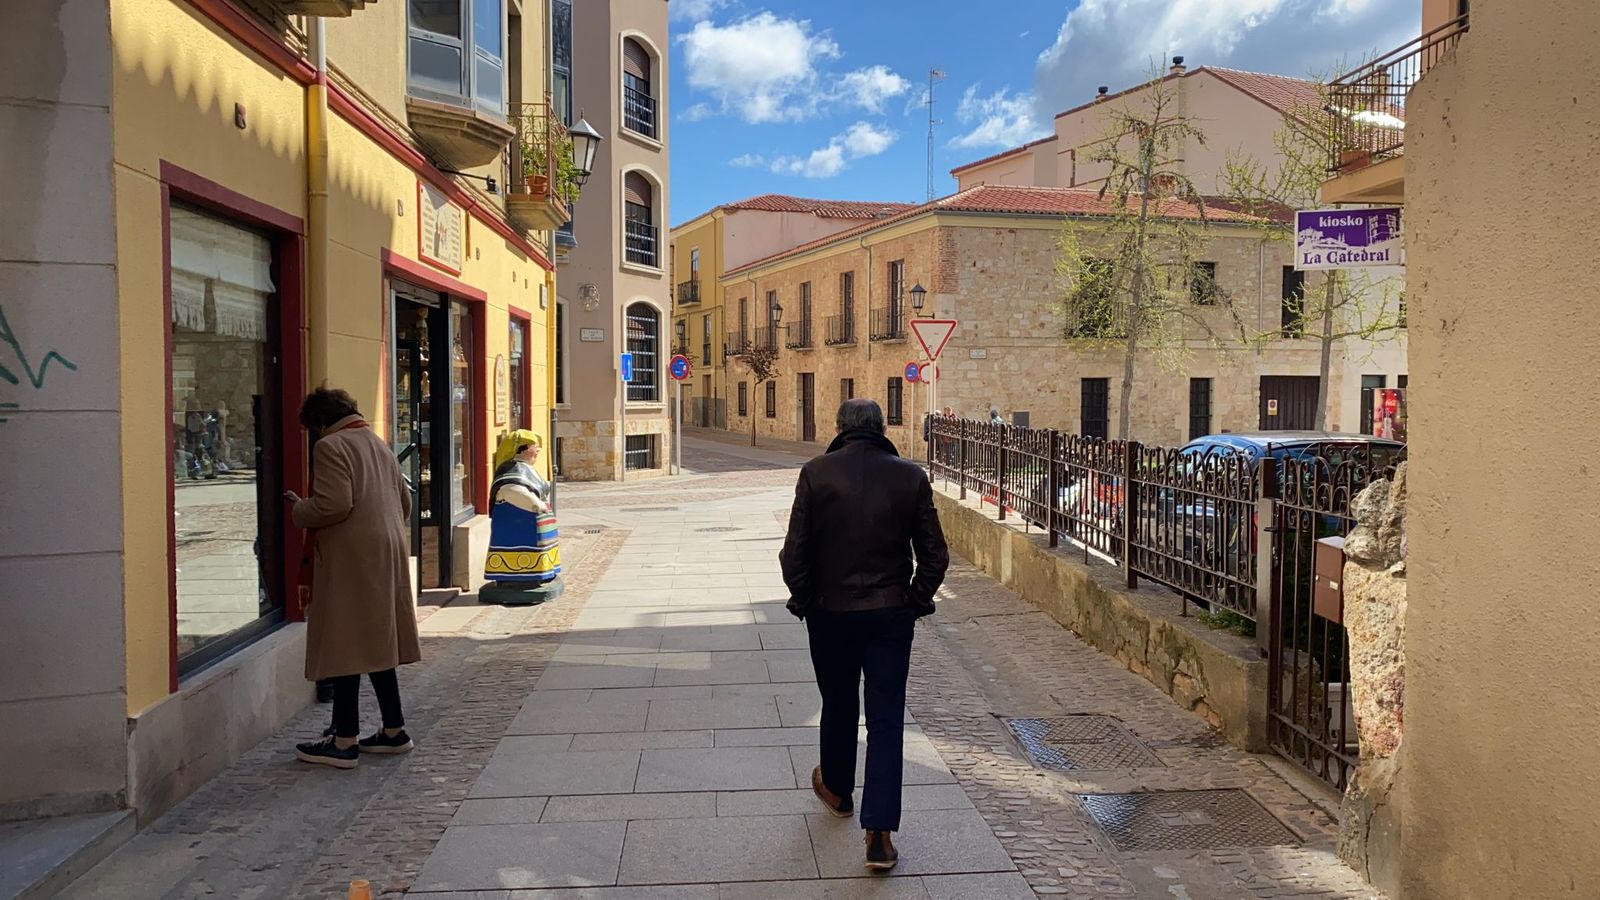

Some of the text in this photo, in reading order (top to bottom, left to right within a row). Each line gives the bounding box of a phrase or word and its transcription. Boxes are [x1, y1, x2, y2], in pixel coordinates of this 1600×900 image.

[1319, 215, 1363, 227] kiosko
[1303, 248, 1390, 266] La Catedral
